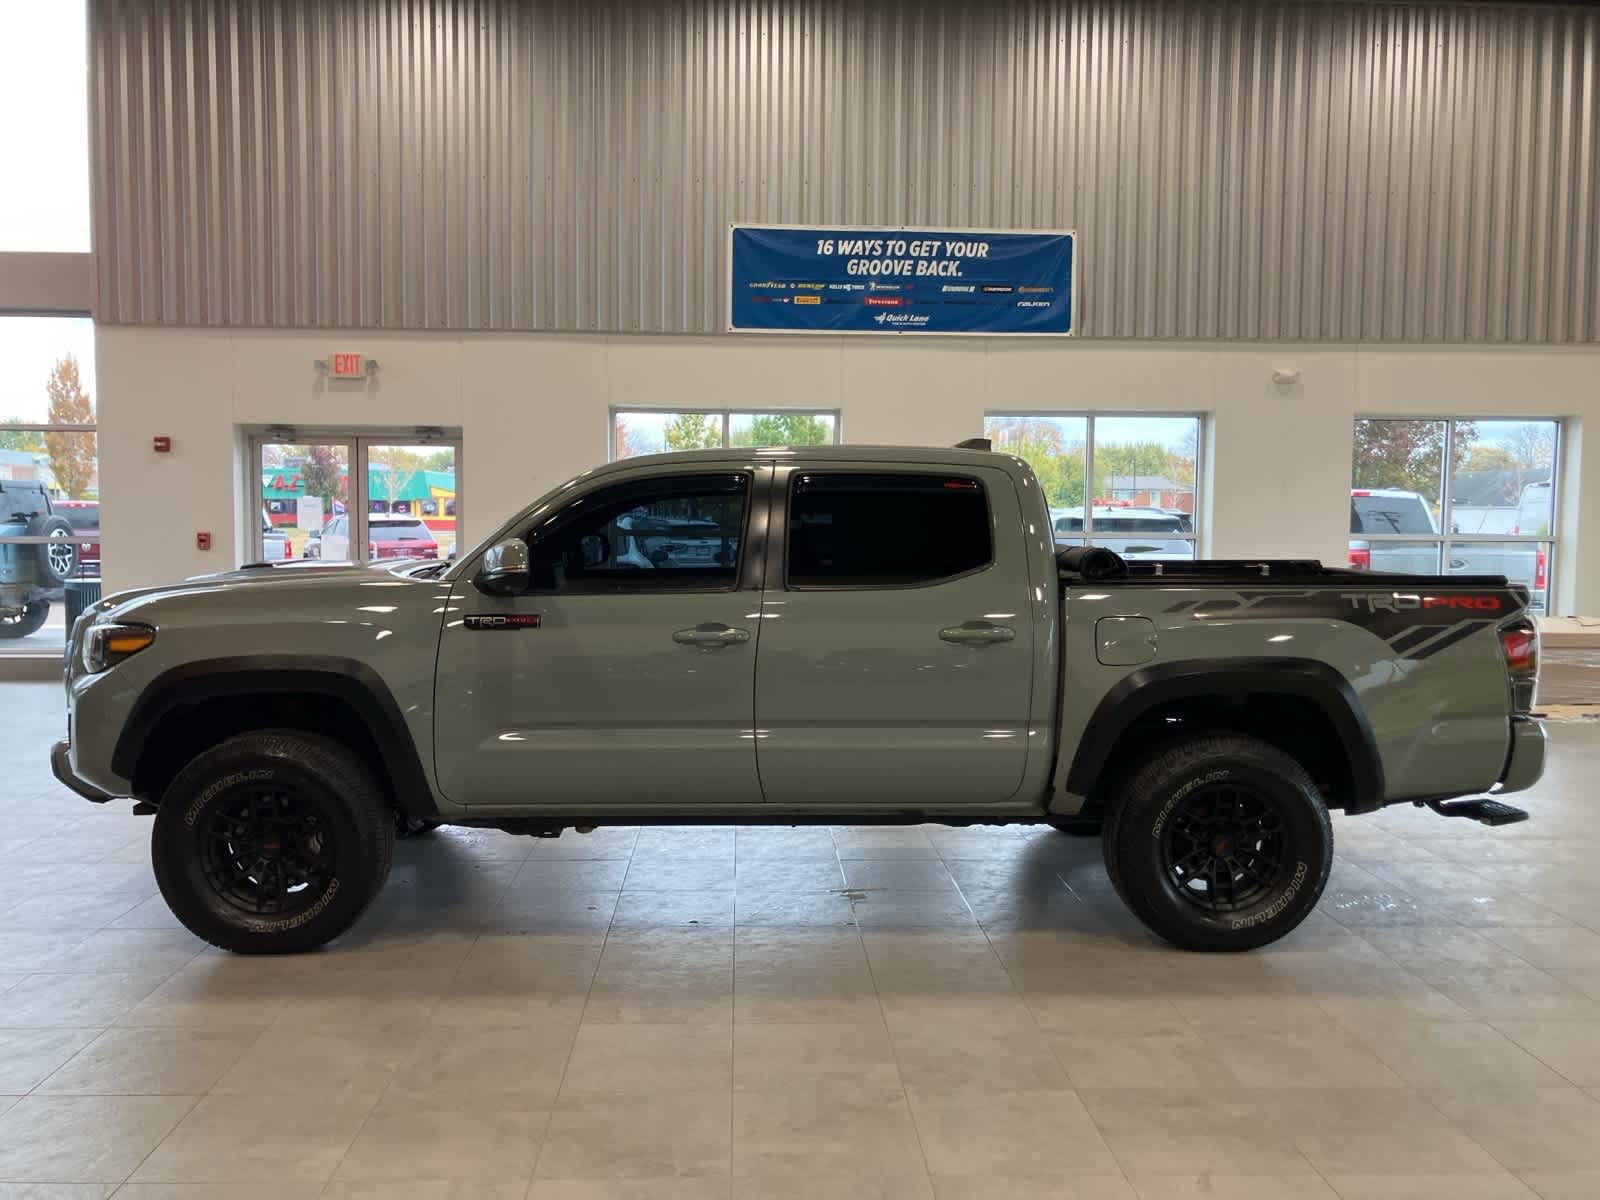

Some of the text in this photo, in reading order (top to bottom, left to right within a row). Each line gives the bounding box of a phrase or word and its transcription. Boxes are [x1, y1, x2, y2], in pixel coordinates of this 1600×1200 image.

[816, 239, 989, 257] 16 WAYS TO GET YOUR
[846, 259, 963, 277] GROOVE BACK.
[886, 313, 930, 323] Quick Lane
[334, 353, 361, 375] EXIT
[1340, 592, 1501, 613] TRD PRO
[466, 616, 506, 627] TRD
